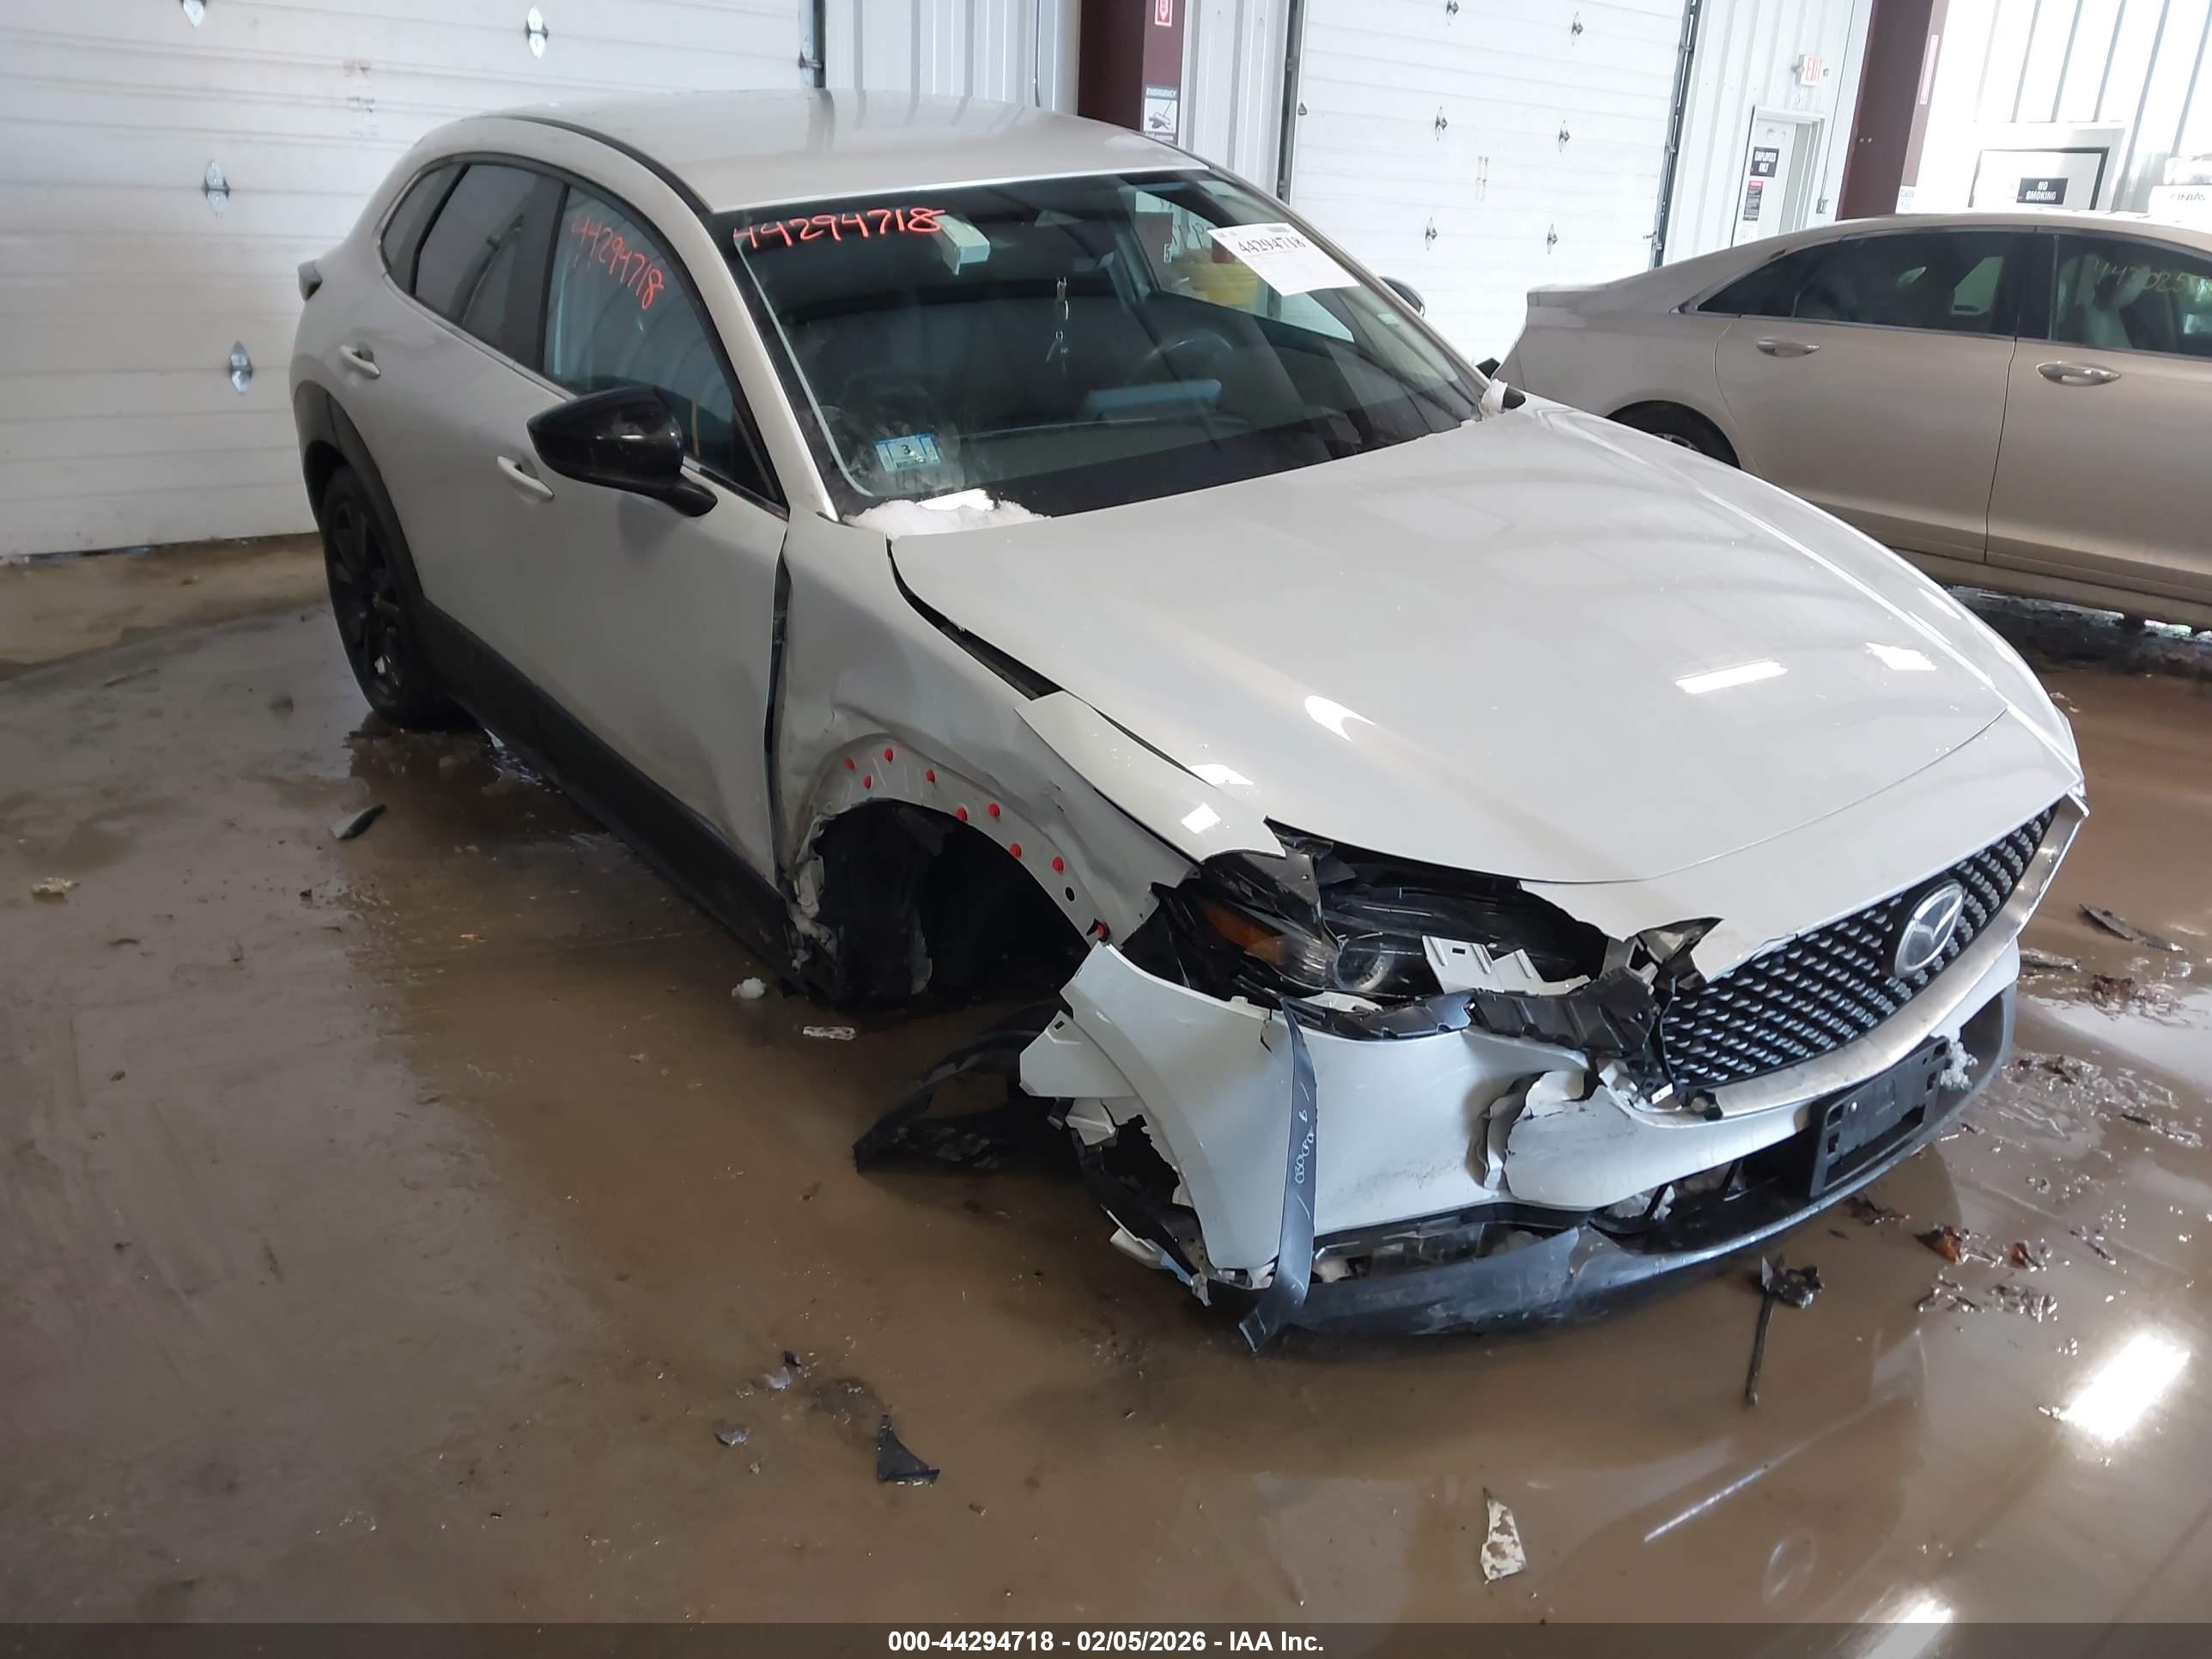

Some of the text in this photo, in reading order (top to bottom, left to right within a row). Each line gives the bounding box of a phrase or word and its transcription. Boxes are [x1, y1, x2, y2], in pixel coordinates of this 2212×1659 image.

[1806, 58, 1822, 82] EXIT
[2038, 180, 2049, 191] NO
[2026, 191, 2057, 201] SMOKING
[732, 207, 946, 249] 44294718
[1238, 236, 1306, 253] 44294718
[572, 214, 665, 310] 44294718
[901, 444, 911, 455] 3
